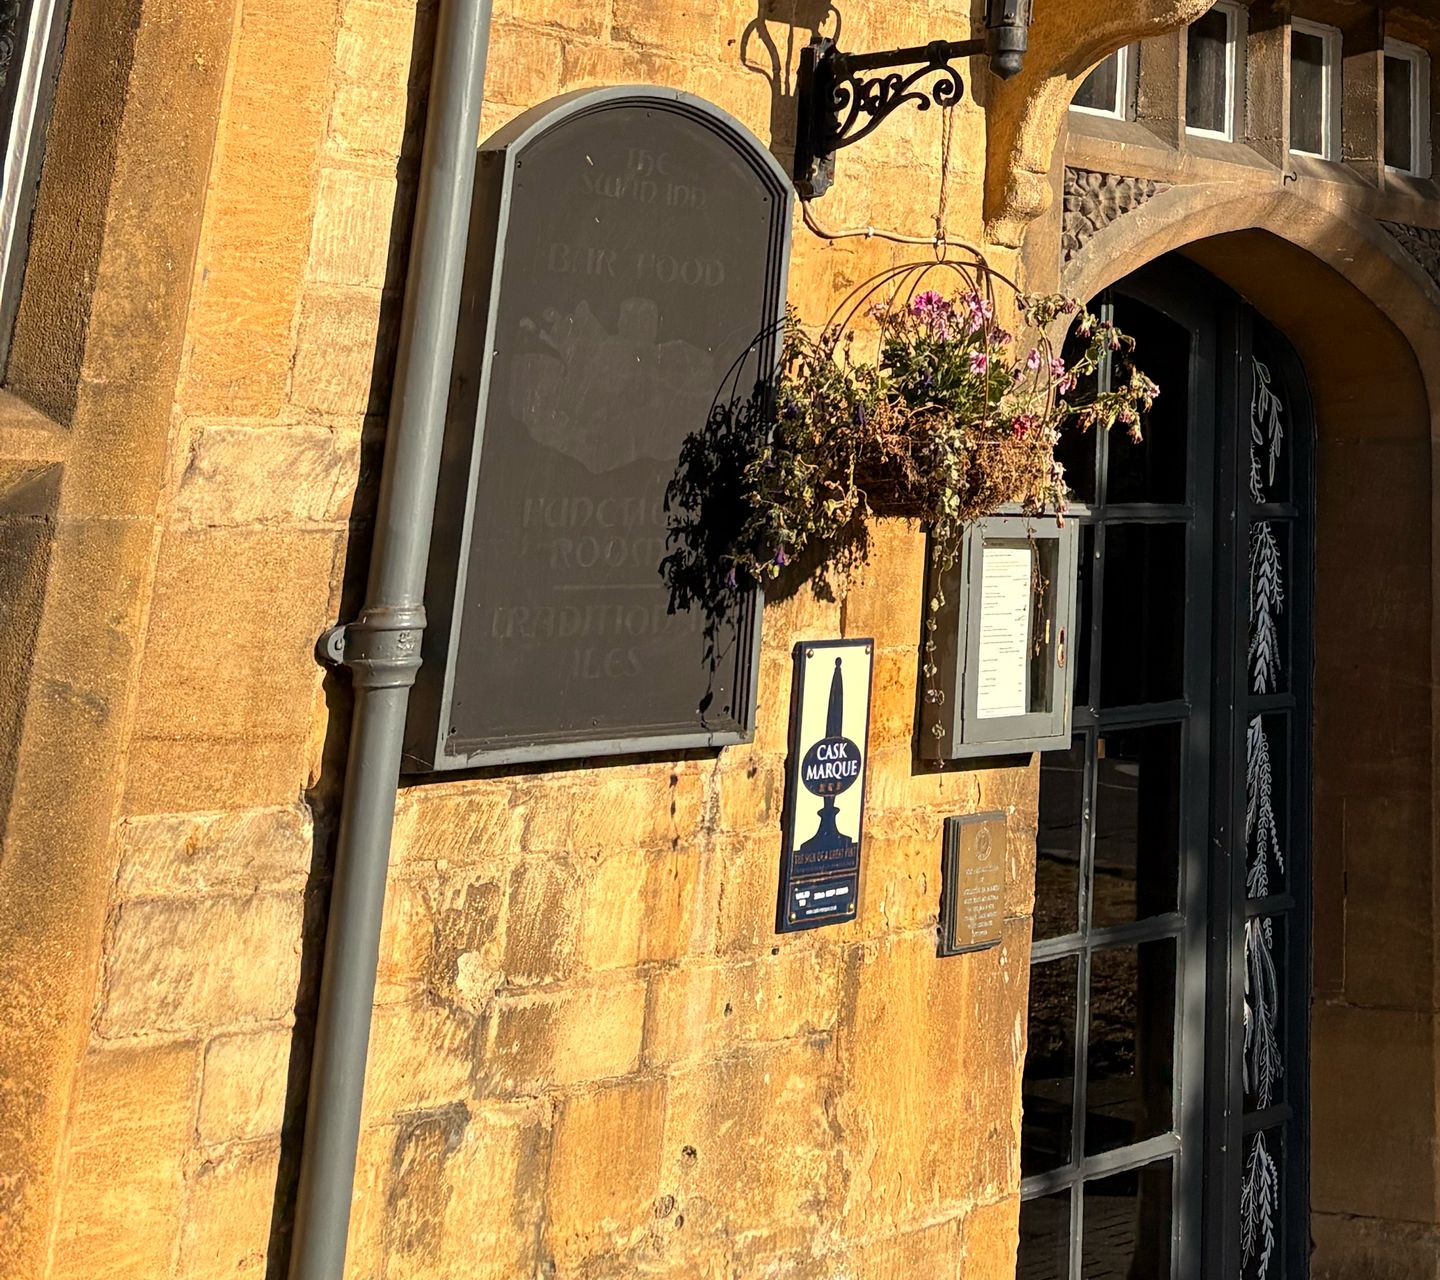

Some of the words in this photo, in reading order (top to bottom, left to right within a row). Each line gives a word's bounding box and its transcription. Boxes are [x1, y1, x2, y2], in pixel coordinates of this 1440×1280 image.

[522, 495, 667, 529] FUNCTIO
[491, 604, 697, 639] TRADITION
[817, 743, 847, 760] CASK
[805, 759, 858, 781] MARQUE
